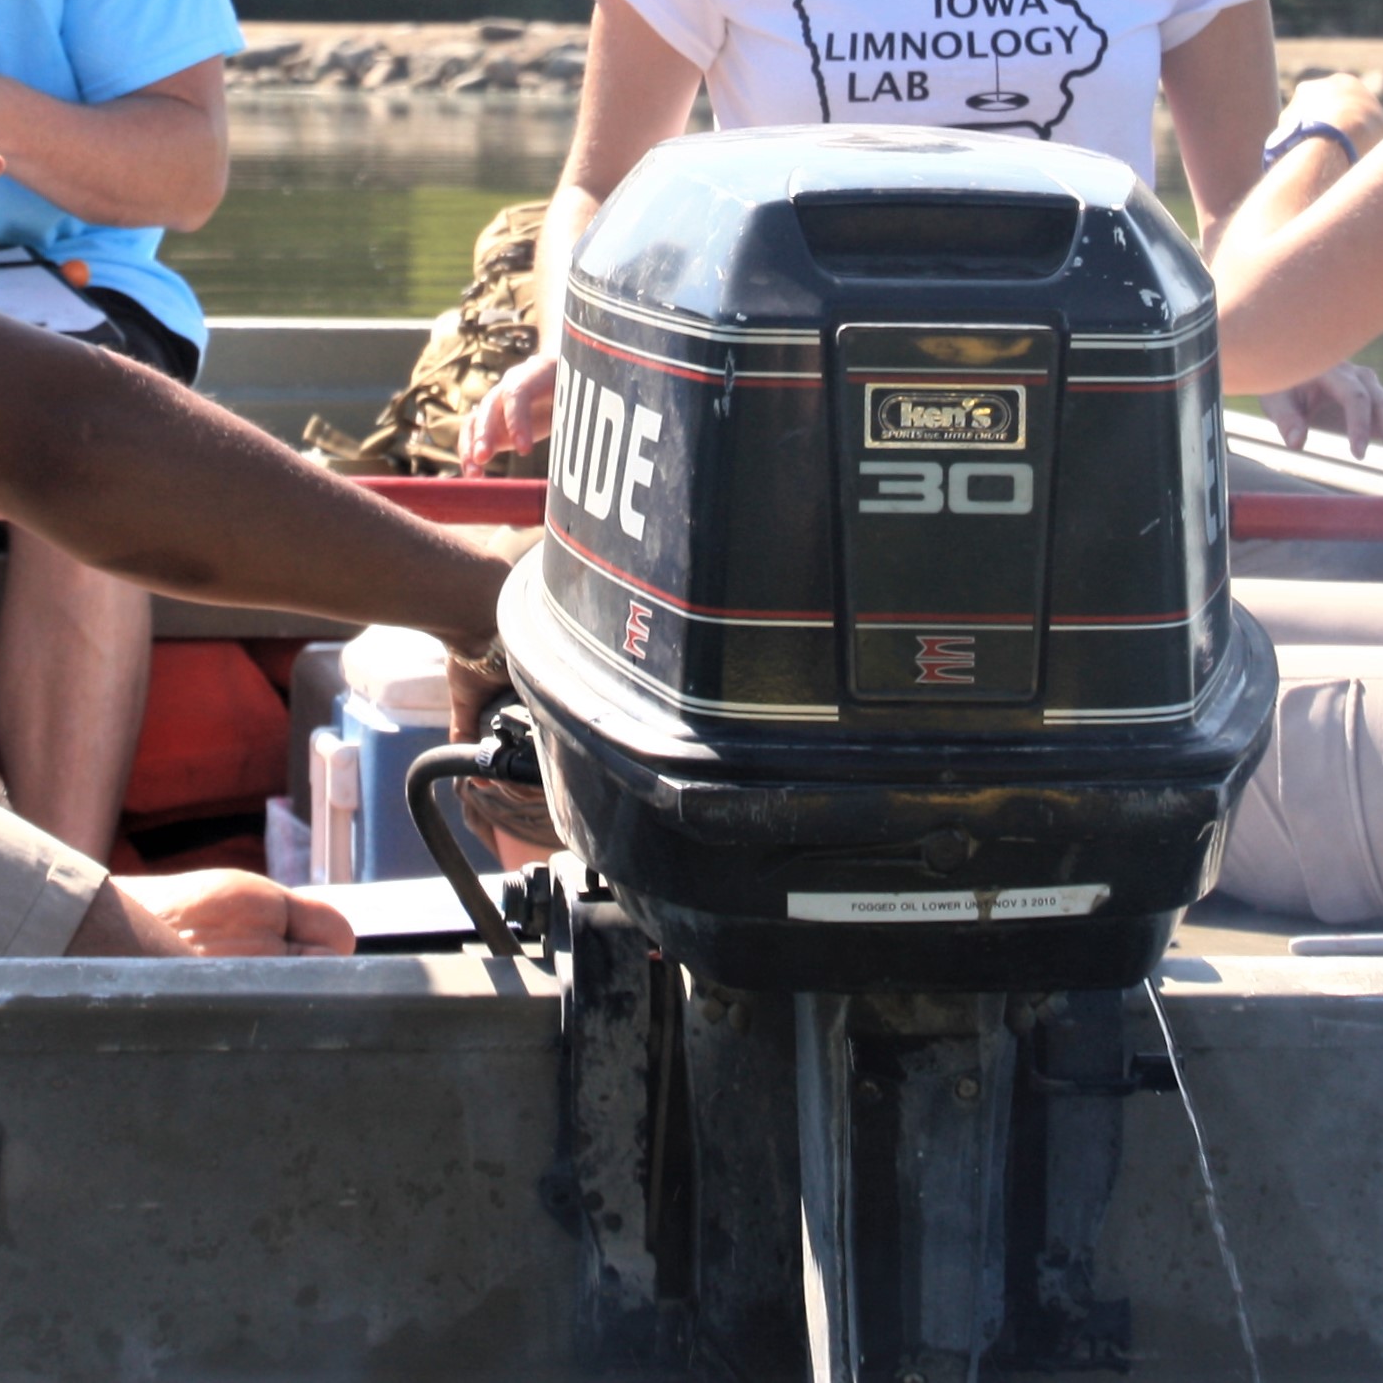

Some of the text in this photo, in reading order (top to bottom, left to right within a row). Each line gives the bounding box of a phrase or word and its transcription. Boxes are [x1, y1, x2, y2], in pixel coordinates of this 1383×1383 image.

[825, 26, 1079, 62] LIMNOLOGY
[848, 71, 930, 104] LAB
[859, 461, 1034, 515] 30
[851, 902, 897, 913] FOGGED
[900, 902, 918, 912] OIL
[921, 900, 961, 912] LOWER
[993, 898, 1017, 909] NOV
[1020, 898, 1027, 908] 3
[1031, 896, 1057, 907] 2010
